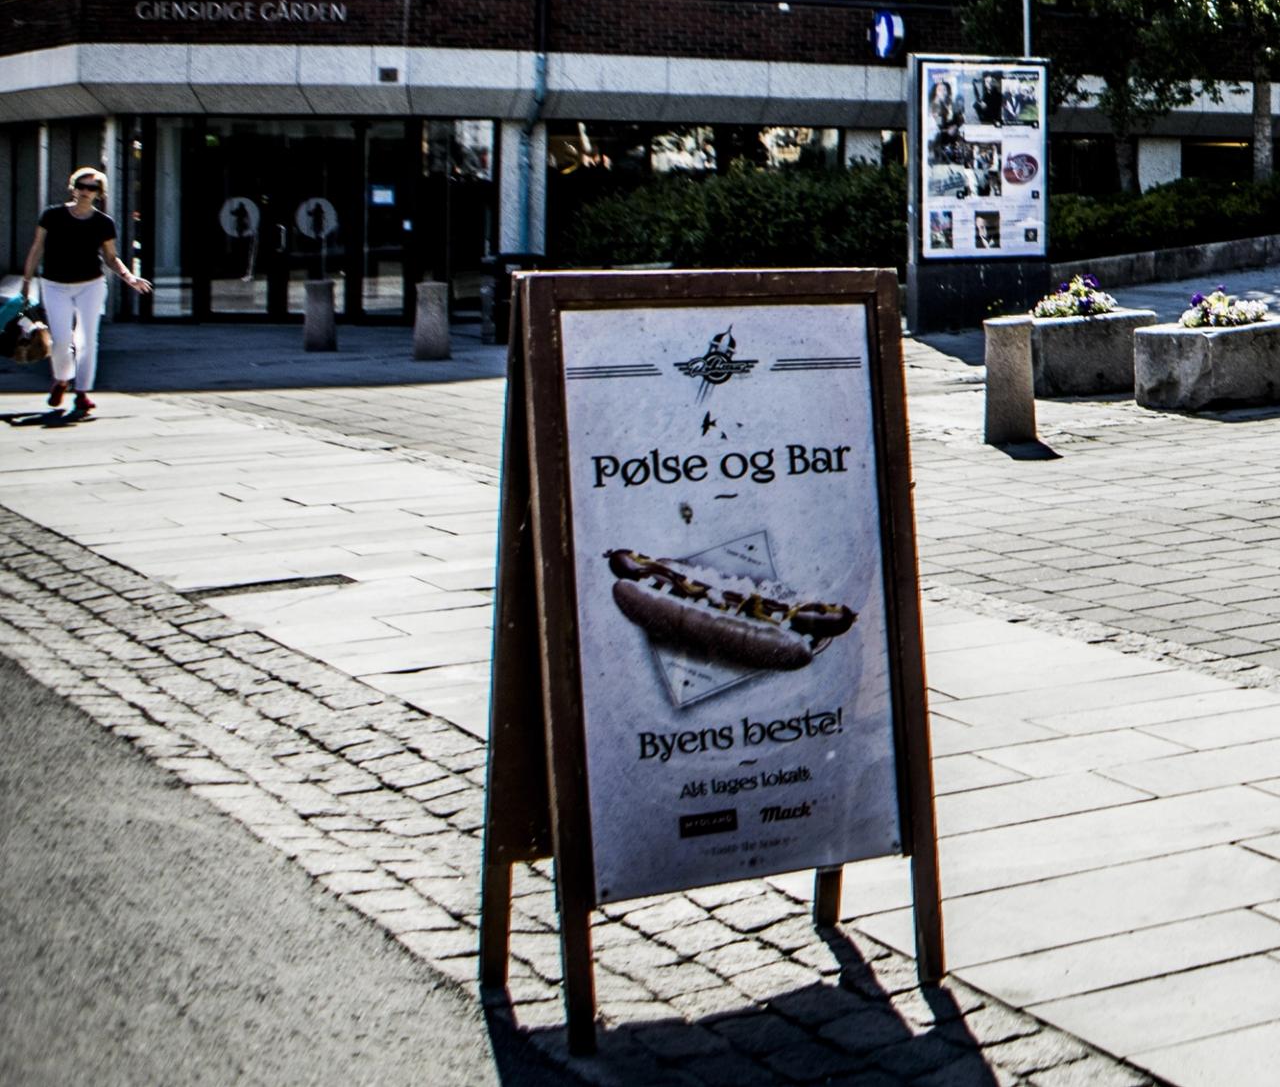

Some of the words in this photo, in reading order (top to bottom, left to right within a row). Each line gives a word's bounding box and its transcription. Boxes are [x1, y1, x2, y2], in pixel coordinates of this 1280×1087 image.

[135, 1, 255, 22] GJENSIDIGE
[591, 448, 708, 488] Pølse
[719, 448, 776, 484] og
[785, 444, 852, 475] Bar
[637, 724, 734, 763] Byens
[742, 707, 844, 747] beste!
[711, 775, 758, 795] lages
